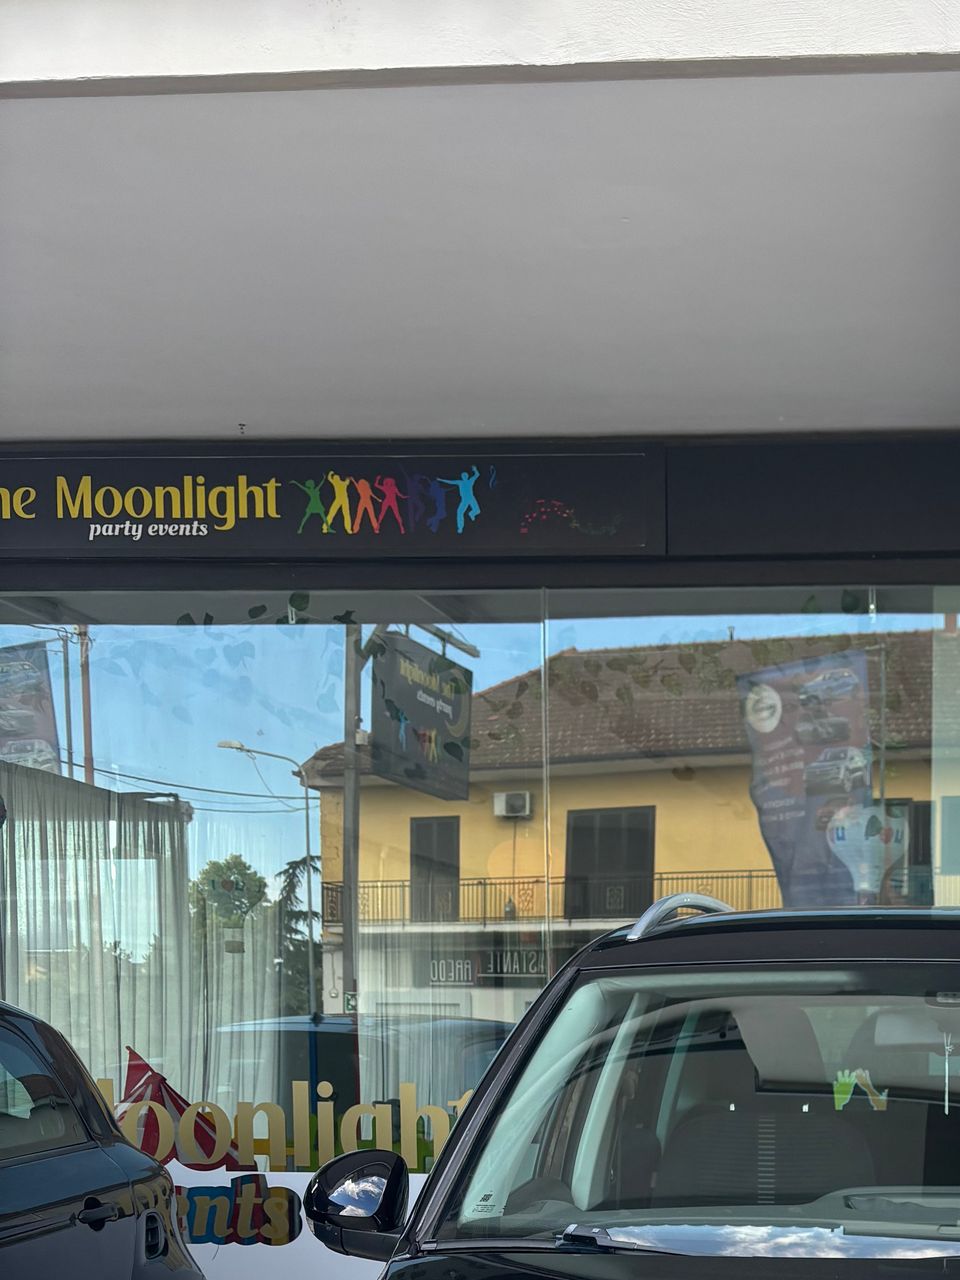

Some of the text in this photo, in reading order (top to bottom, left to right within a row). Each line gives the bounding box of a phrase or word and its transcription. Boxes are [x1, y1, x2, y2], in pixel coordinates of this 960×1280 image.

[56, 475, 282, 531] Moonlight
[88, 520, 208, 541] party events
[97, 1078, 477, 1169] oonligh
